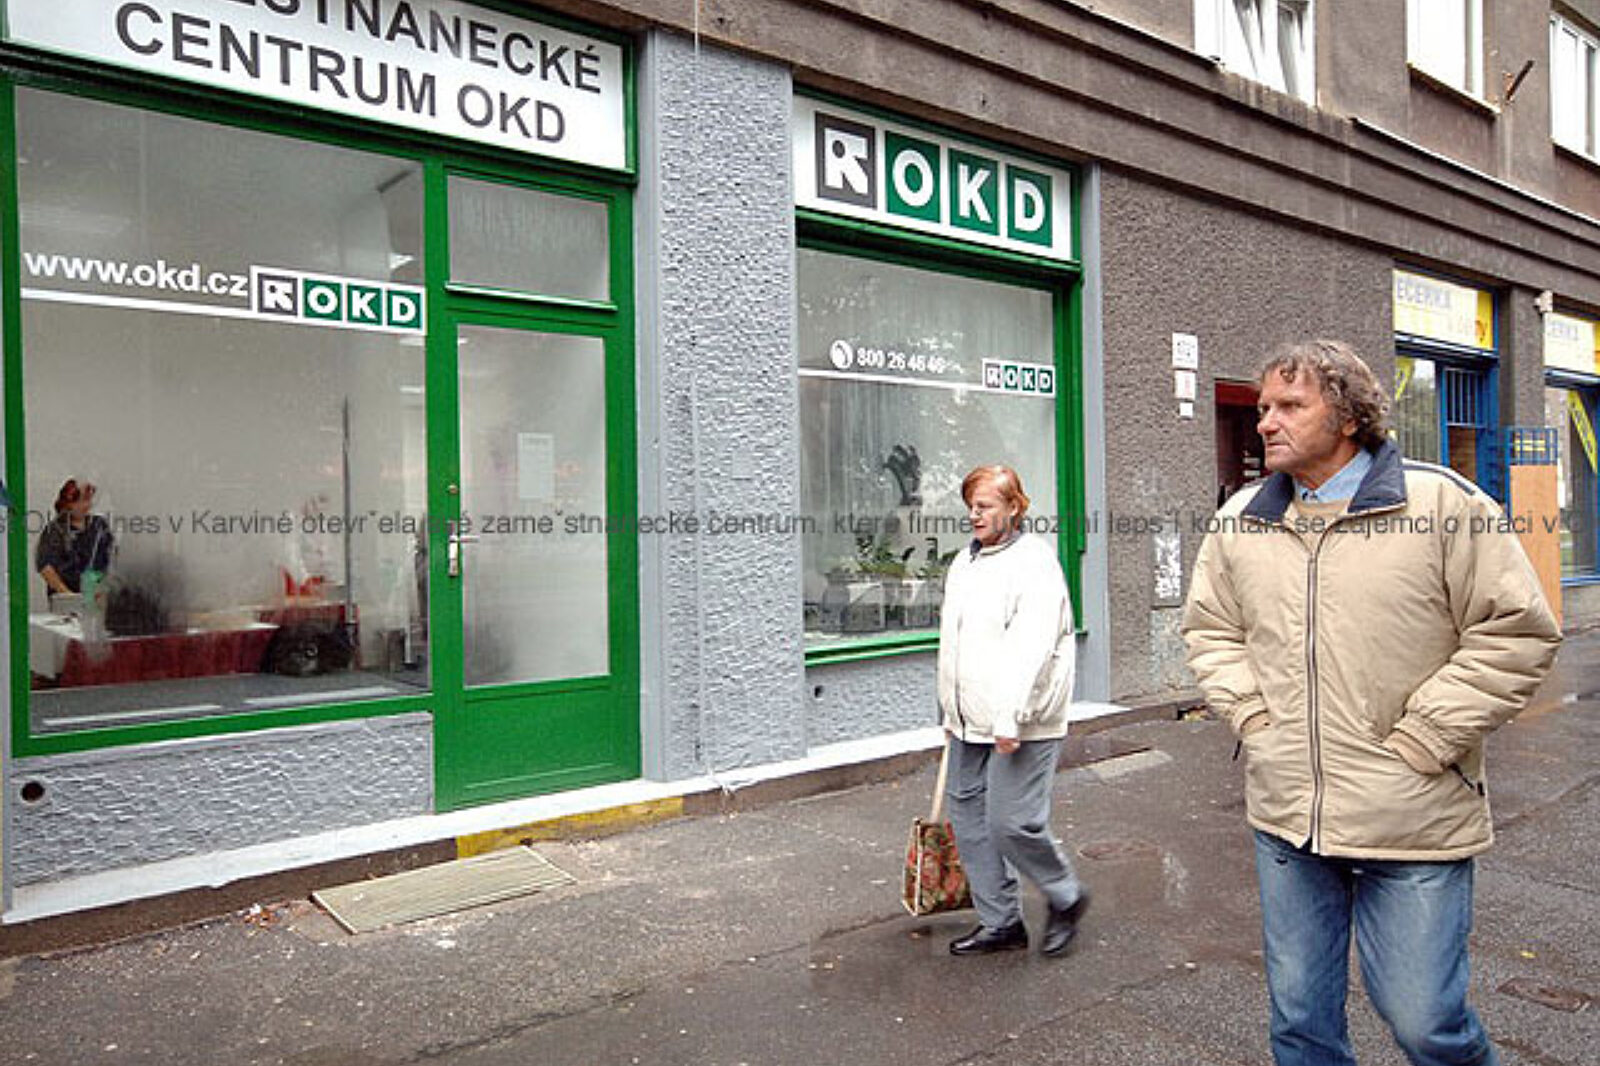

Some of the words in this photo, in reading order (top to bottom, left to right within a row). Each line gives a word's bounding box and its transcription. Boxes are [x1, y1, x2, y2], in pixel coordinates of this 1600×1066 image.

[115, 2, 438, 117] CENTRUM
[457, 82, 566, 144] OKD
[24, 251, 249, 297] www.okd.cz
